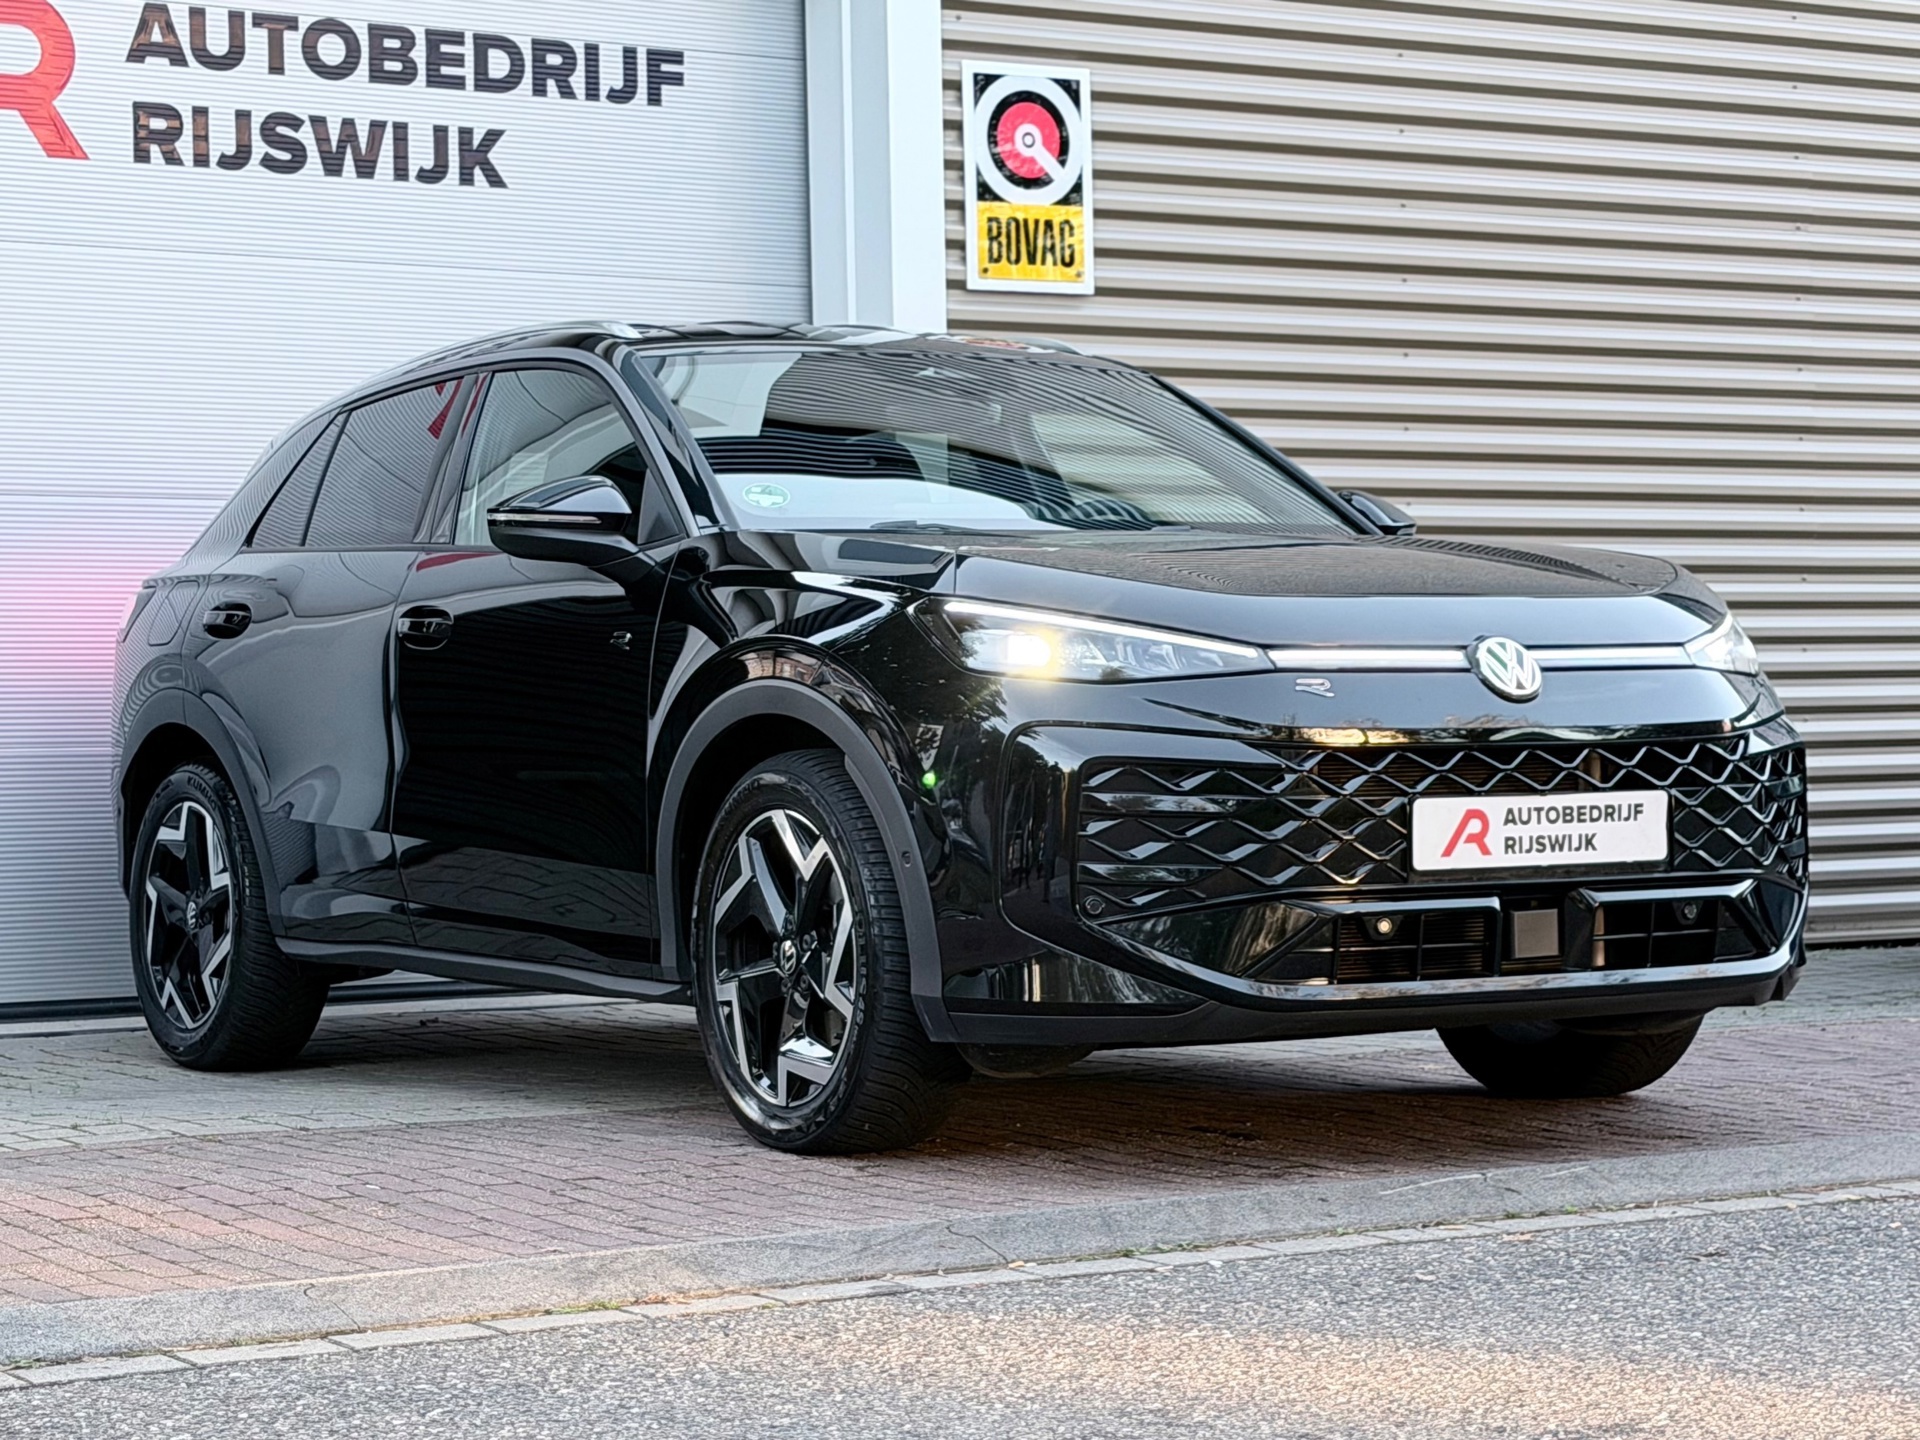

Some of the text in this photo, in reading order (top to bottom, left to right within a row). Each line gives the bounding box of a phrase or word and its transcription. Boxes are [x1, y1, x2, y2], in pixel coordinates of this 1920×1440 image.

[125, 2, 685, 107] AUTOBEDRIJF
[132, 101, 508, 189] RIJSWIJK
[986, 216, 1076, 268] BOVAG
[1502, 802, 1644, 827] AUTOBEDRIJF
[1503, 832, 1598, 855] RIJSWIJK
